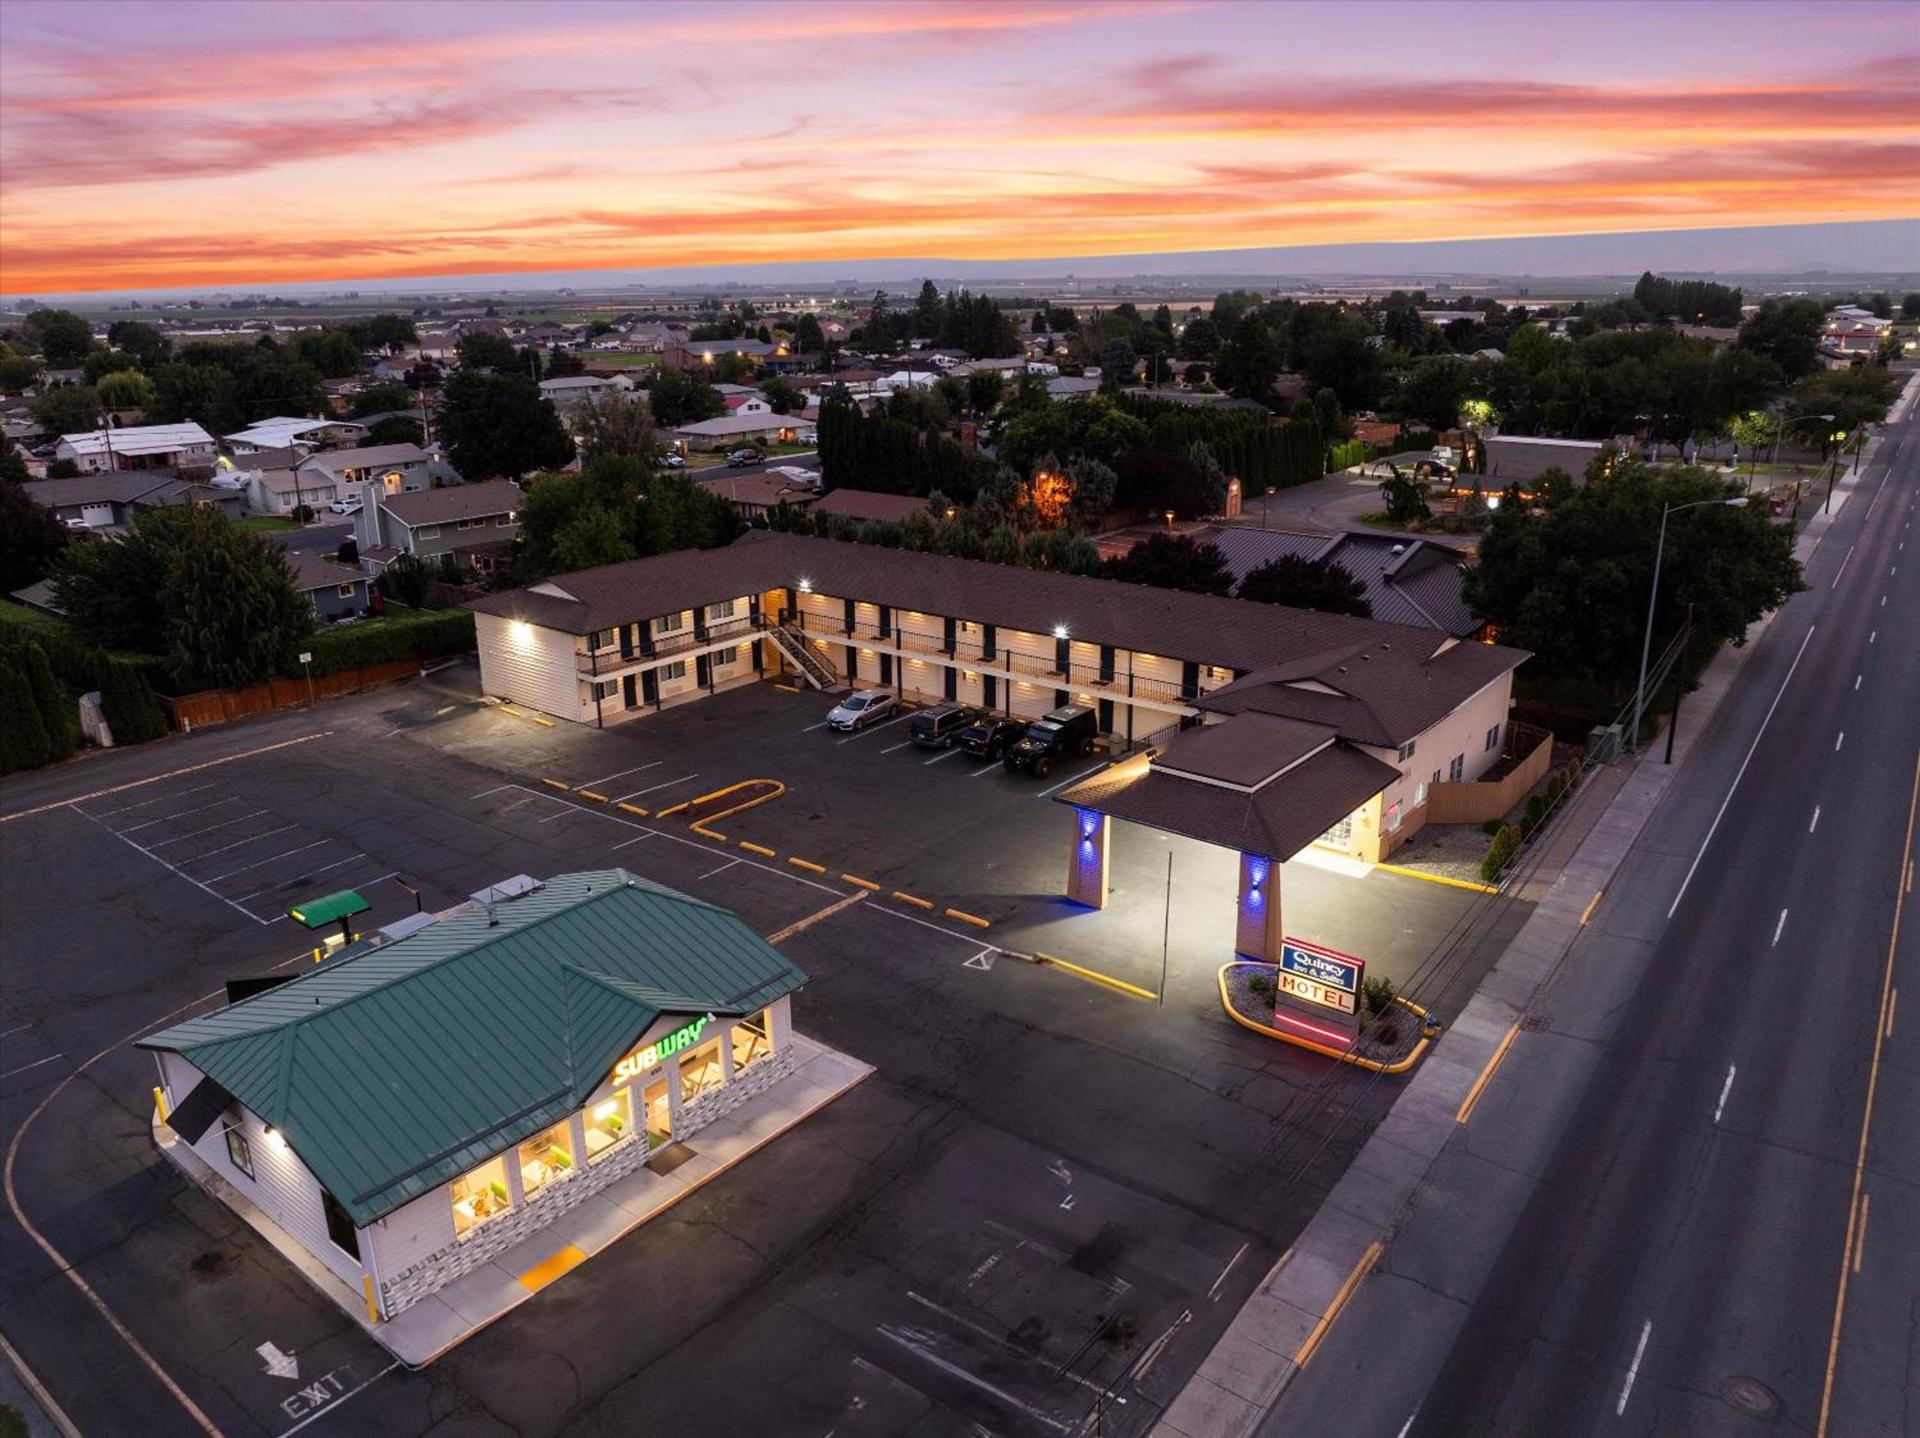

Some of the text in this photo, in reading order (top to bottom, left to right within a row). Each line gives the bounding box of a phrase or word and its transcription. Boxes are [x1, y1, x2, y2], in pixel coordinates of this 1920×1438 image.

[1293, 951, 1345, 976] Quincy
[1293, 963, 1345, 985] Inn & Suites
[1283, 976, 1351, 1009] MOTEL
[612, 1017, 707, 1086] SUBWAY
